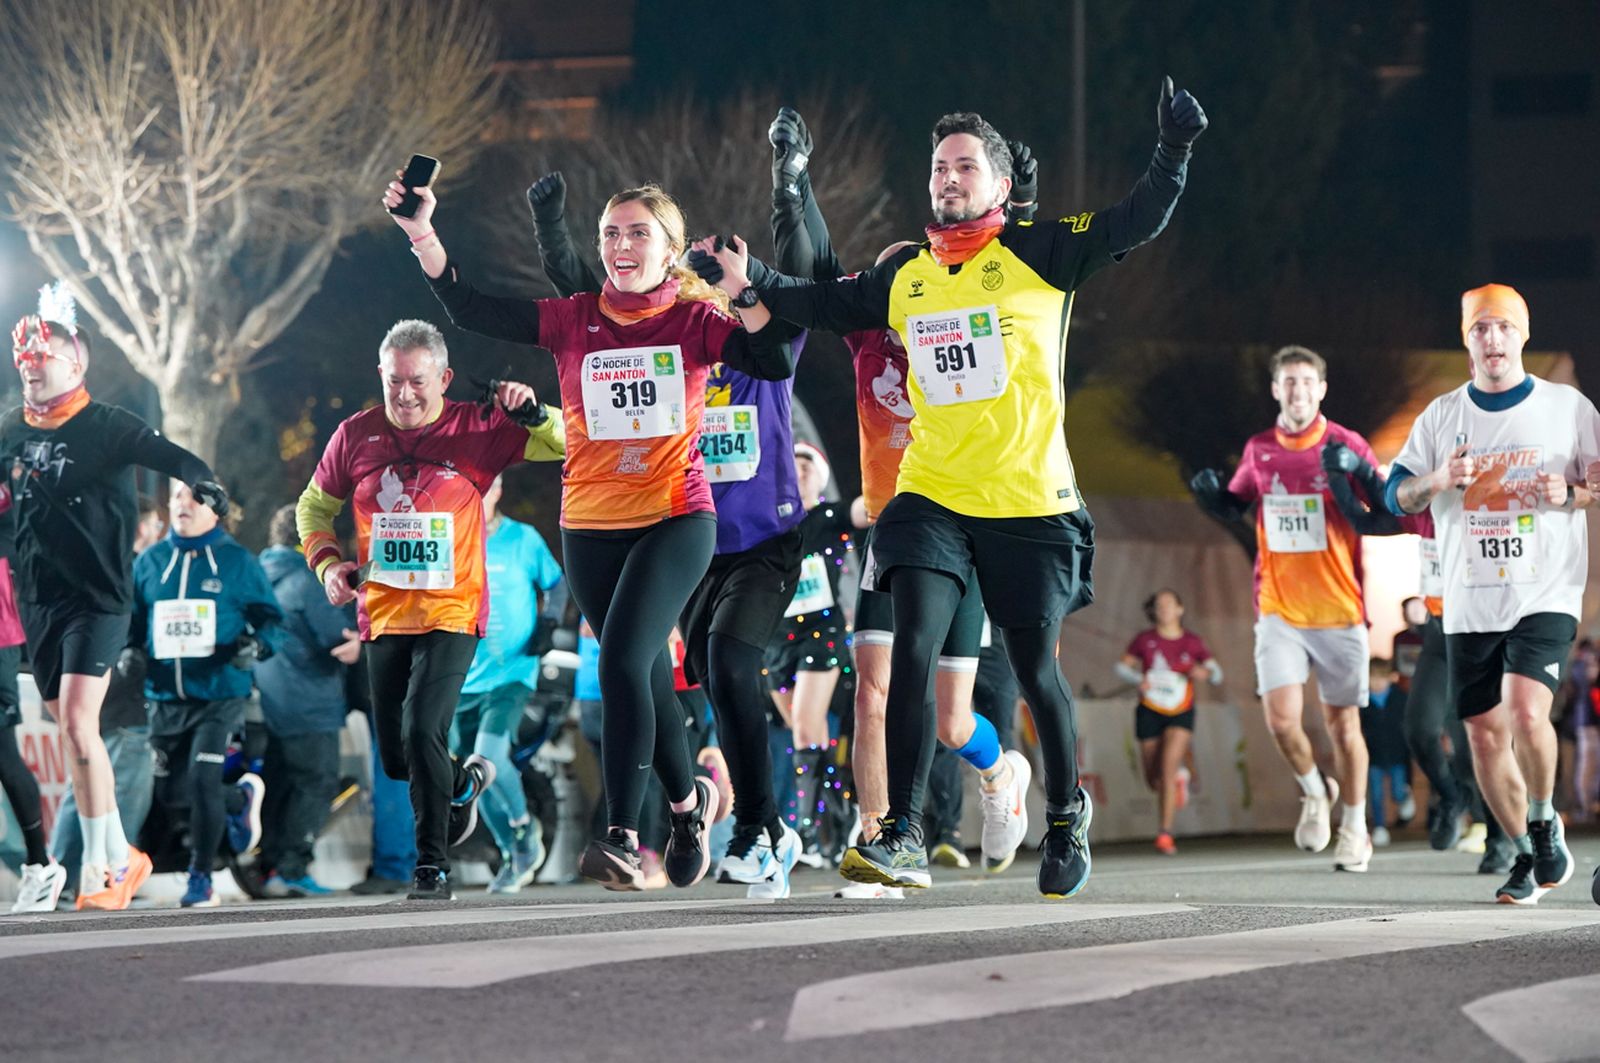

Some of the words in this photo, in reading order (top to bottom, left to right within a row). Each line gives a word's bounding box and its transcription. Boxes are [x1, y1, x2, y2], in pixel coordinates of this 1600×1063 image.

[926, 322, 949, 334] NOCHE
[949, 321, 961, 330] DE
[918, 335, 935, 347] SAN
[602, 359, 632, 369] NOCHE
[633, 358, 645, 367] DE
[934, 342, 977, 374] 591
[592, 371, 612, 383] SAN
[610, 380, 657, 409] 319
[717, 415, 727, 423] DE
[698, 433, 748, 457] 2154
[388, 521, 412, 530] NOCHE
[413, 521, 423, 530] DE
[1278, 516, 1309, 531] 7511
[1478, 519, 1499, 527] NOCHE
[1500, 518, 1510, 527] DE
[380, 530, 395, 539] SAN
[383, 540, 440, 563] 9043
[1478, 537, 1523, 559] 1313
[165, 621, 203, 637] 4835
